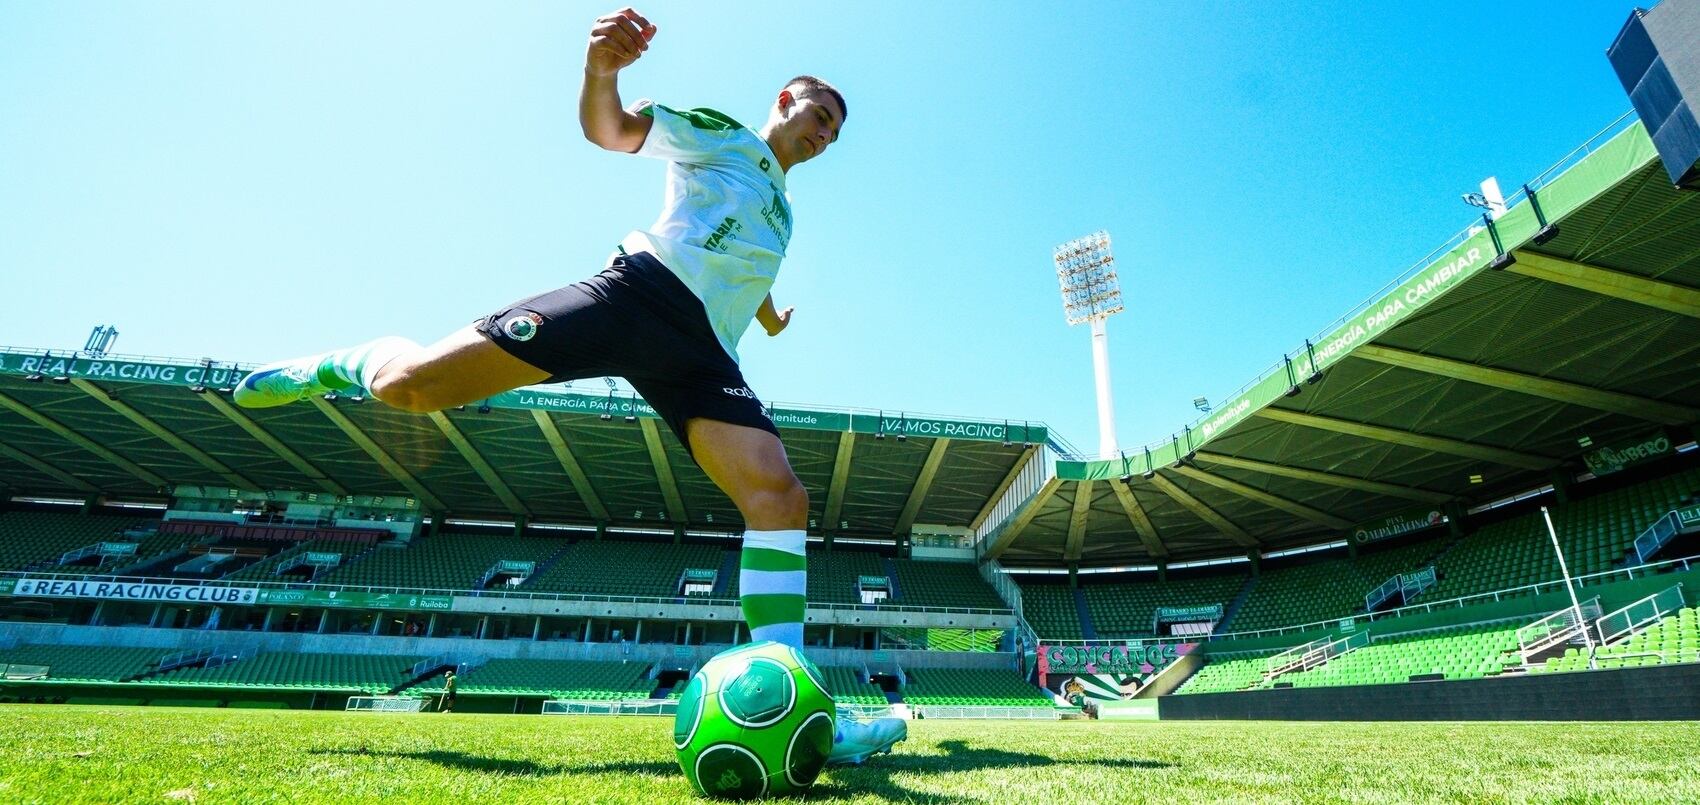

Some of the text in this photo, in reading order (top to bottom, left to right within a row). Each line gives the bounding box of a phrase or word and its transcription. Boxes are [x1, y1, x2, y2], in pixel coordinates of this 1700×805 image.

[1297, 359, 1312, 376] LA
[1366, 299, 1405, 331] PARA
[1405, 247, 1482, 304] CAMBIAR
[19, 357, 242, 385] REAL RACING CLUB
[519, 395, 656, 414] LA ENERGÍA PARA CAMB
[880, 418, 941, 434] ¡VAMOS
[34, 581, 241, 602] REAL RACING CLUB
[420, 600, 449, 609] Ruiloba
